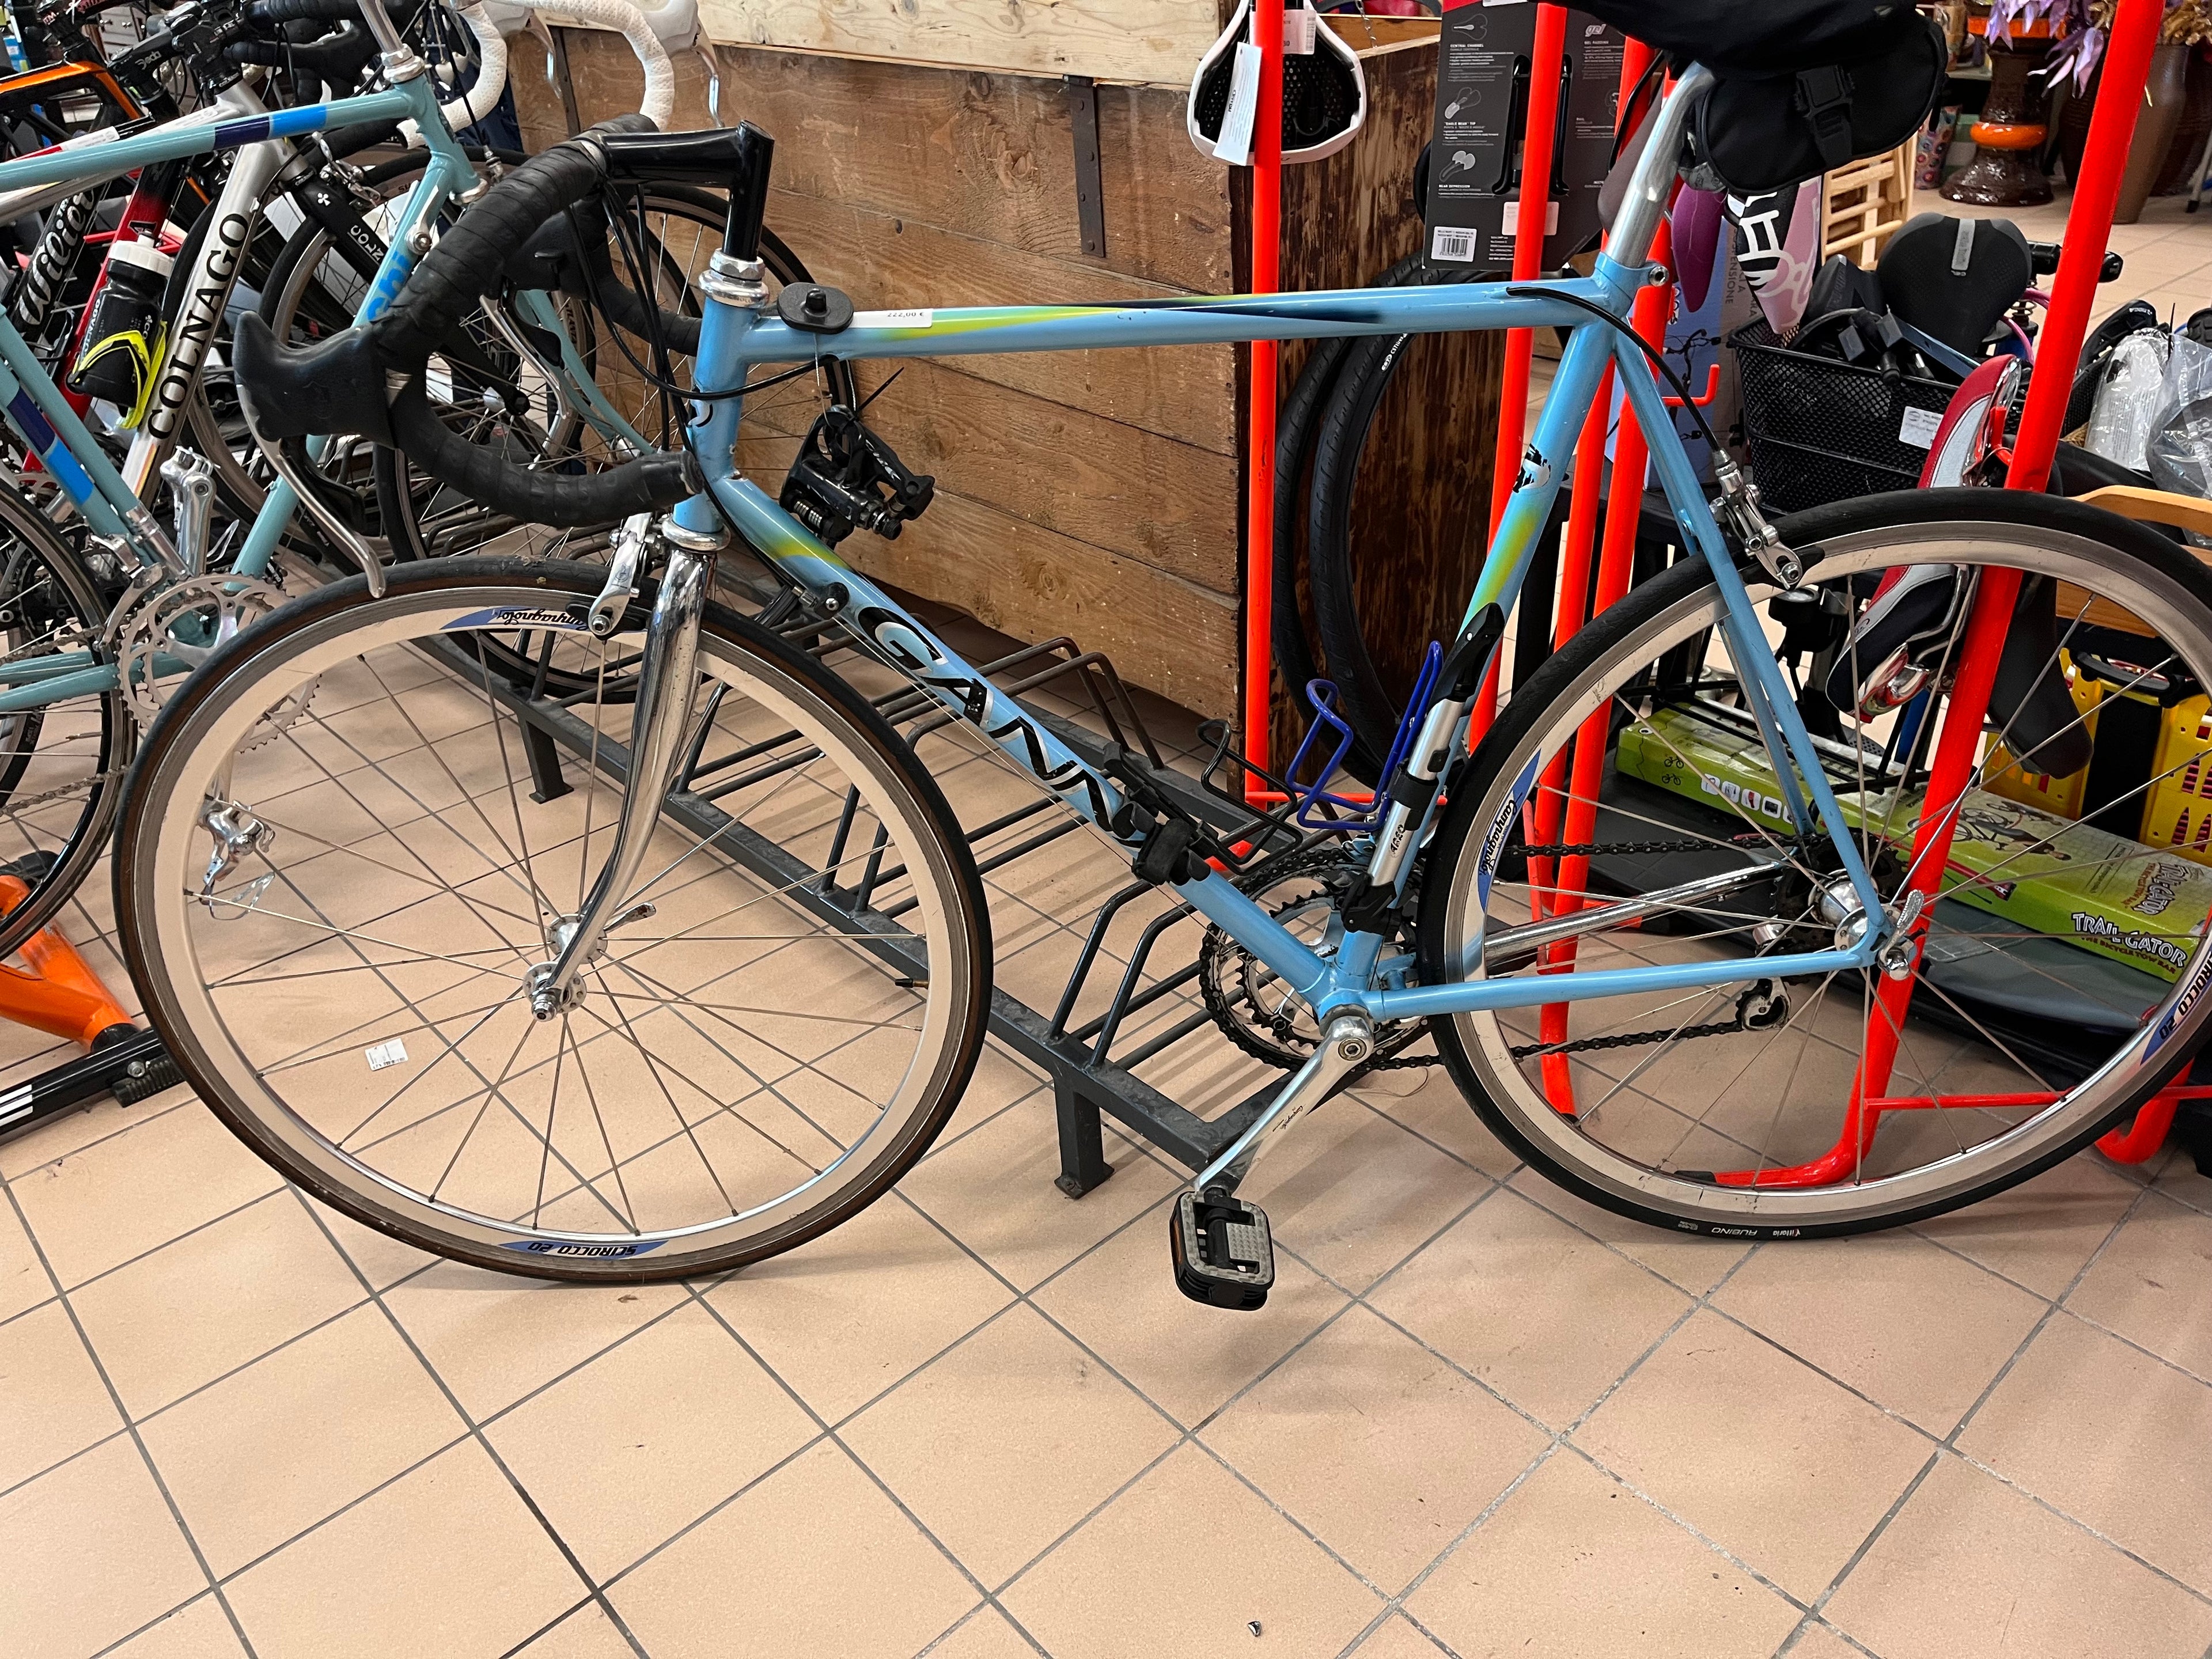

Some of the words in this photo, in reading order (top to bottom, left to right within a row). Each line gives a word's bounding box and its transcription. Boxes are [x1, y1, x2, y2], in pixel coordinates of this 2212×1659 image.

[1585, 24, 1607, 37] gel
[350, 225, 384, 262] COLN
[147, 213, 249, 440] COLNAGO
[497, 609, 589, 631] mpagnolo
[857, 607, 1143, 847] GANN
[1479, 797, 1521, 874] Campagnolo
[2178, 950, 2212, 1016] IROCCO
[2160, 1016, 2177, 1040] 20
[1711, 1226, 1758, 1236] RUBINO
[1772, 1229, 1801, 1237] Vittoria
[528, 1242, 554, 1253] 20
[557, 1245, 638, 1256] SCIROCCO
